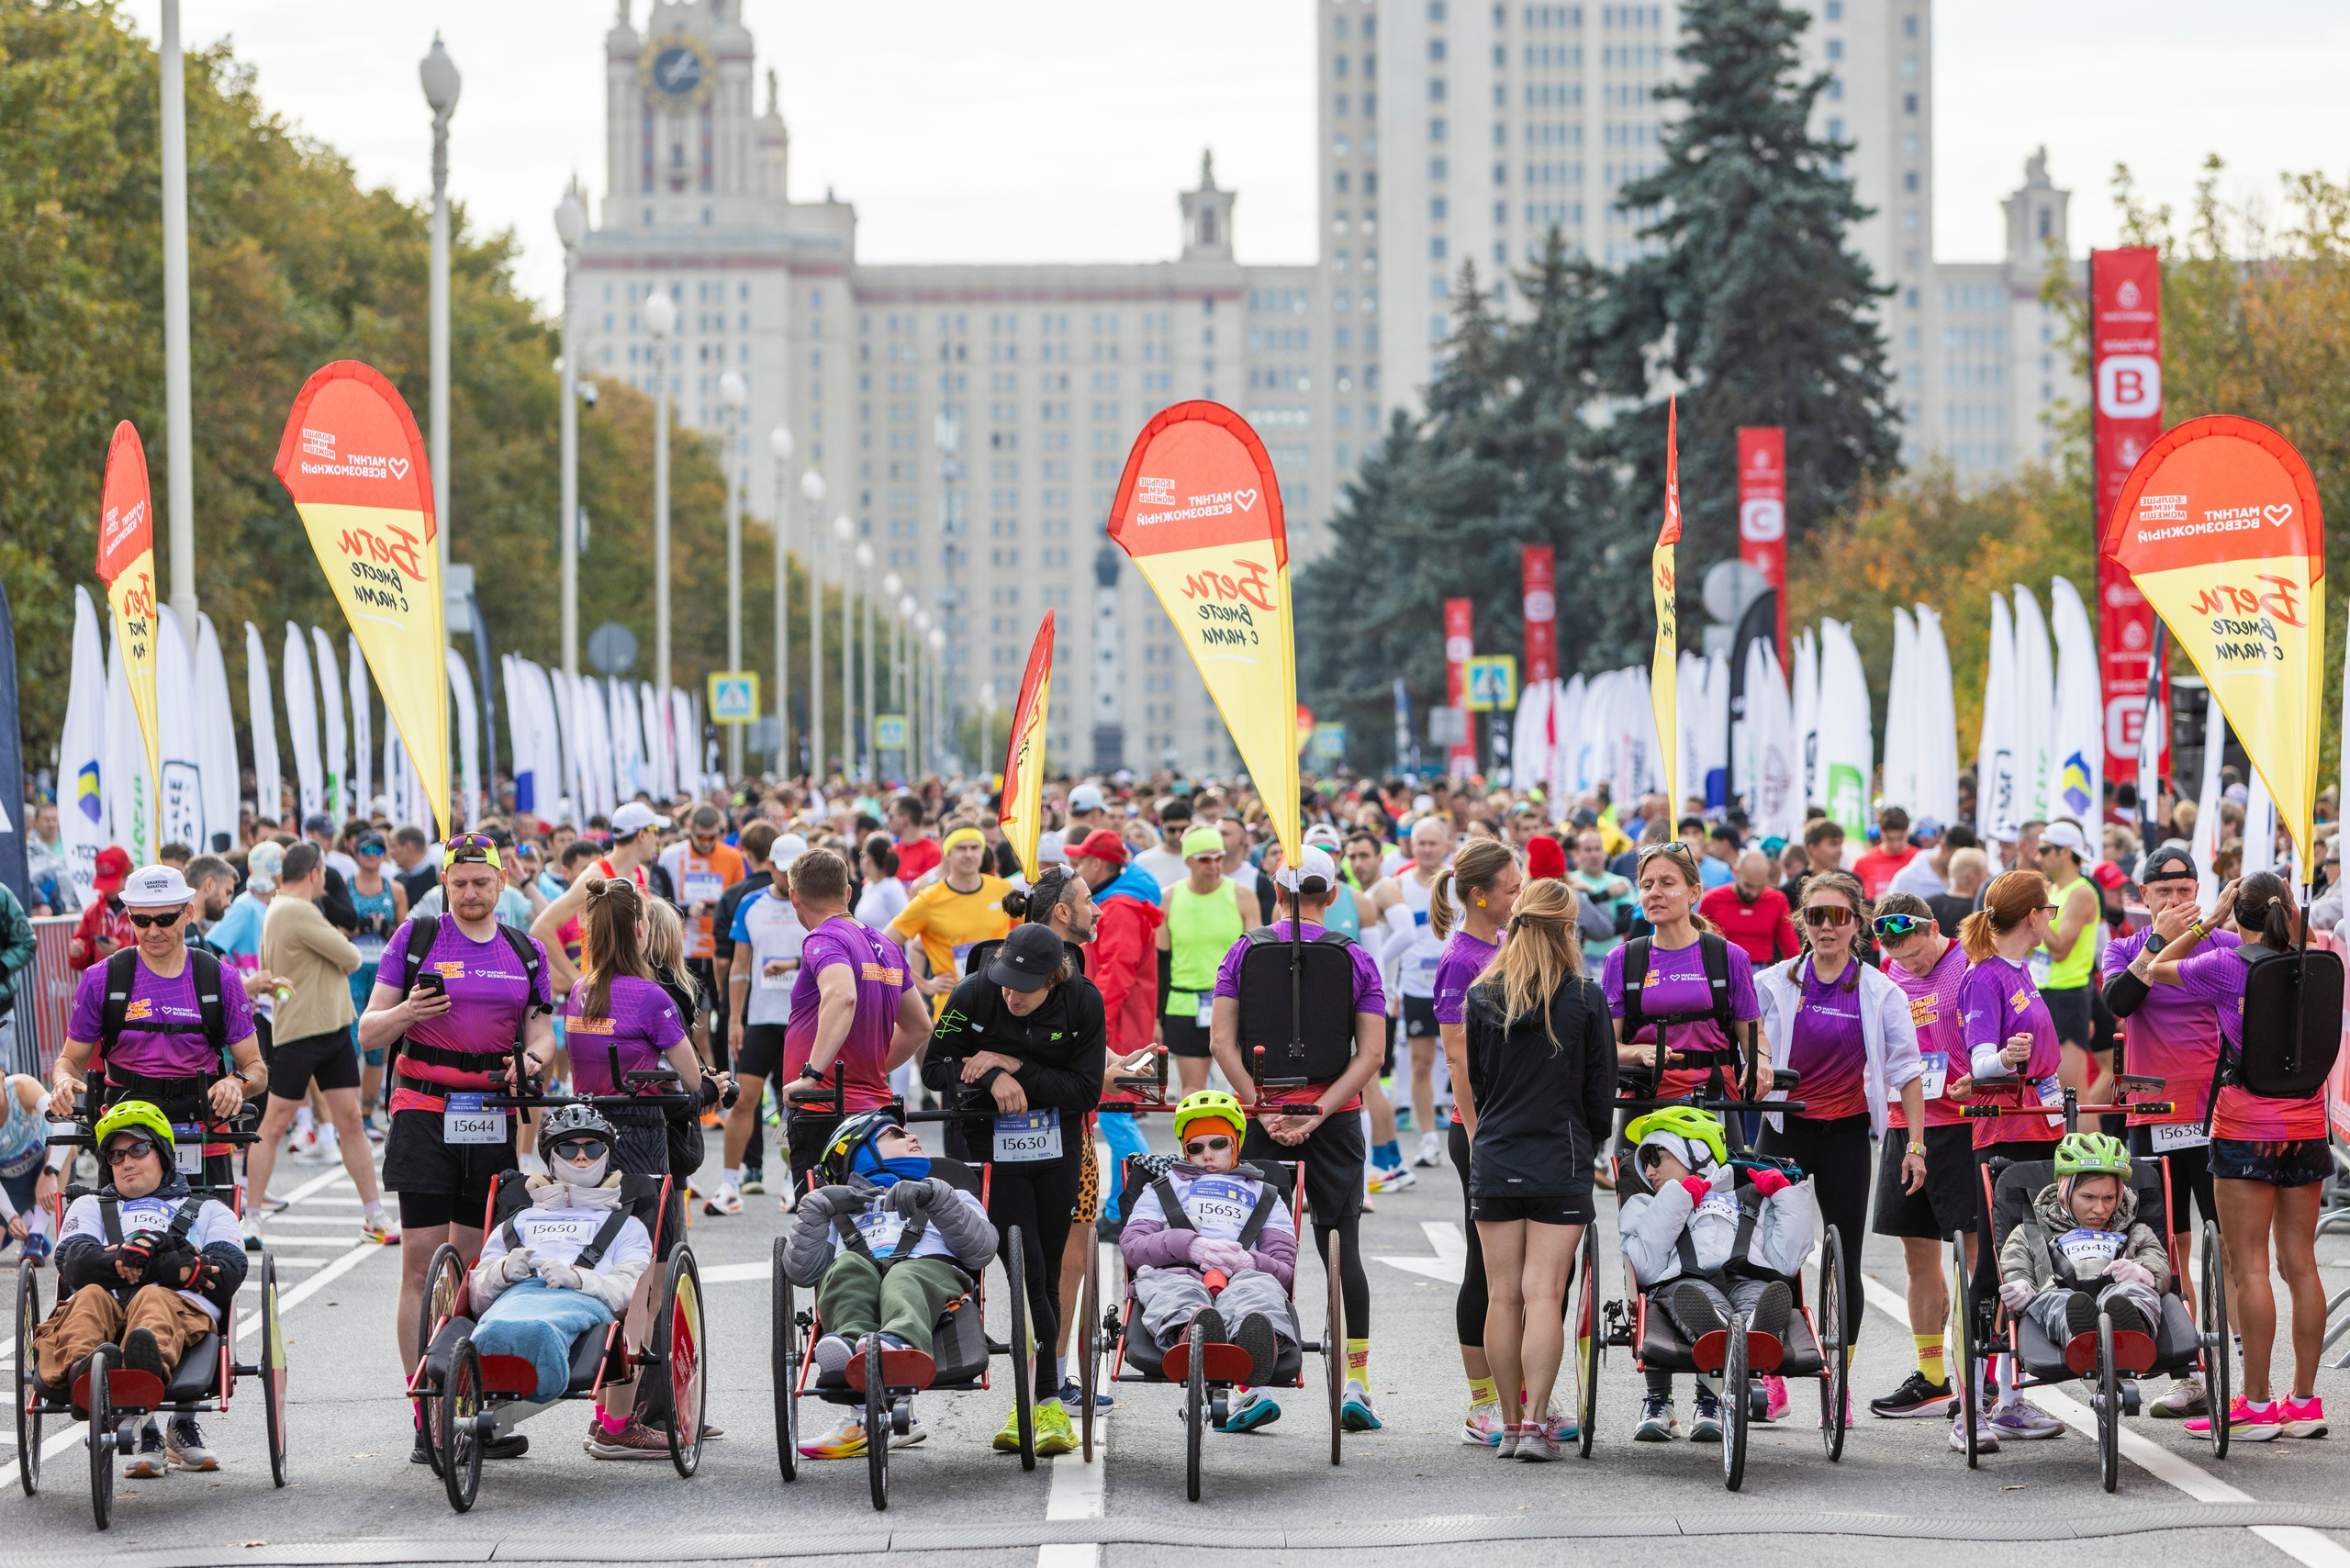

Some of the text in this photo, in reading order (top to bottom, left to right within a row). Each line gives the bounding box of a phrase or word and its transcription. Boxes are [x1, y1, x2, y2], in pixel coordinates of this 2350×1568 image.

[2115, 370, 2143, 404] B
[1909, 994, 1936, 1011] ОЛЬШЕ
[1914, 1012, 1937, 1026] ЖЕШЬ
[453, 1119, 494, 1132] 15644
[2159, 1123, 2202, 1140] 15638
[1002, 1137, 1046, 1150] 15630
[1199, 1203, 1241, 1219] 15653
[133, 1214, 166, 1228] 1565
[532, 1224, 577, 1235] 15650
[2065, 1243, 2111, 1256] 15648
